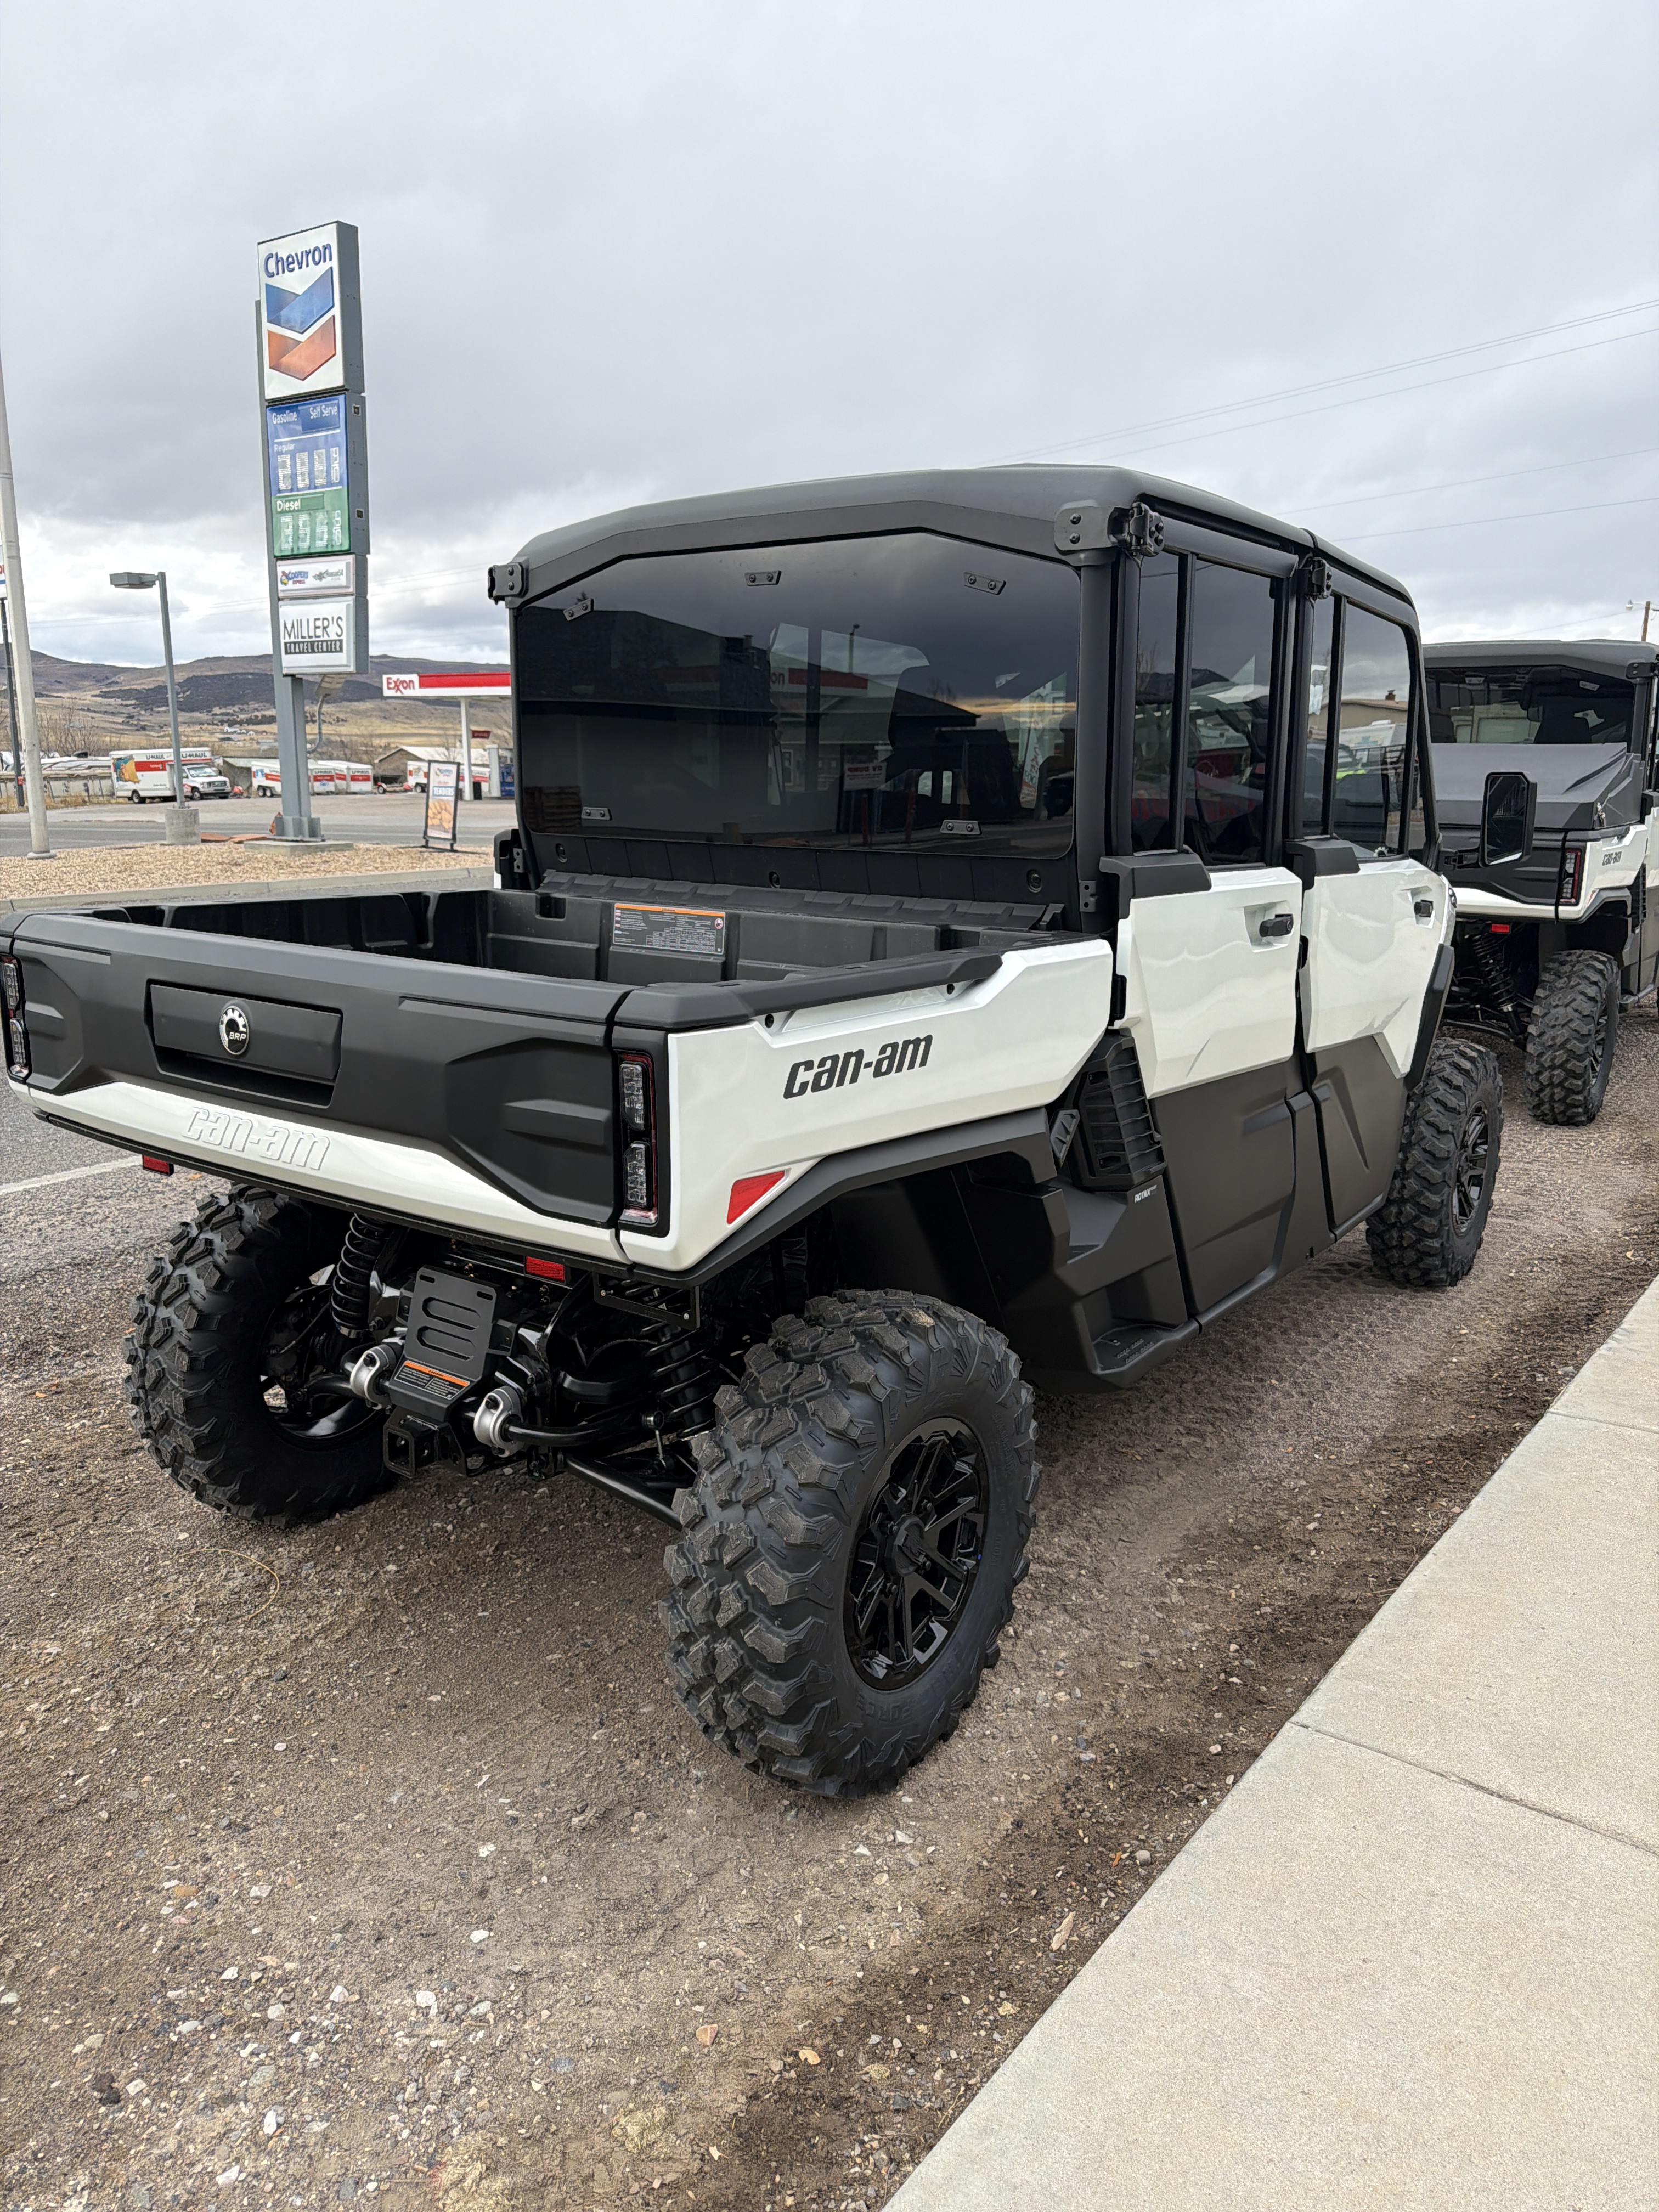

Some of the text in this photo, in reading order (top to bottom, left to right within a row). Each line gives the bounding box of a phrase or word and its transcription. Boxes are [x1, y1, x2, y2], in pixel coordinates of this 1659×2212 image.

[264, 243, 332, 278] Chevron
[272, 410, 297, 425] Gasoline
[309, 405, 338, 419] Self Serve
[276, 499, 301, 511] Diesel
[283, 616, 343, 640] MILLER'S
[286, 640, 340, 653] TRAVEL CENTER
[386, 676, 415, 694] Exxon
[229, 1031, 247, 1042] BRP
[783, 1034, 933, 1099] can-am
[182, 1106, 330, 1171] can-am
[1133, 1188, 1151, 1204] ROTAX
